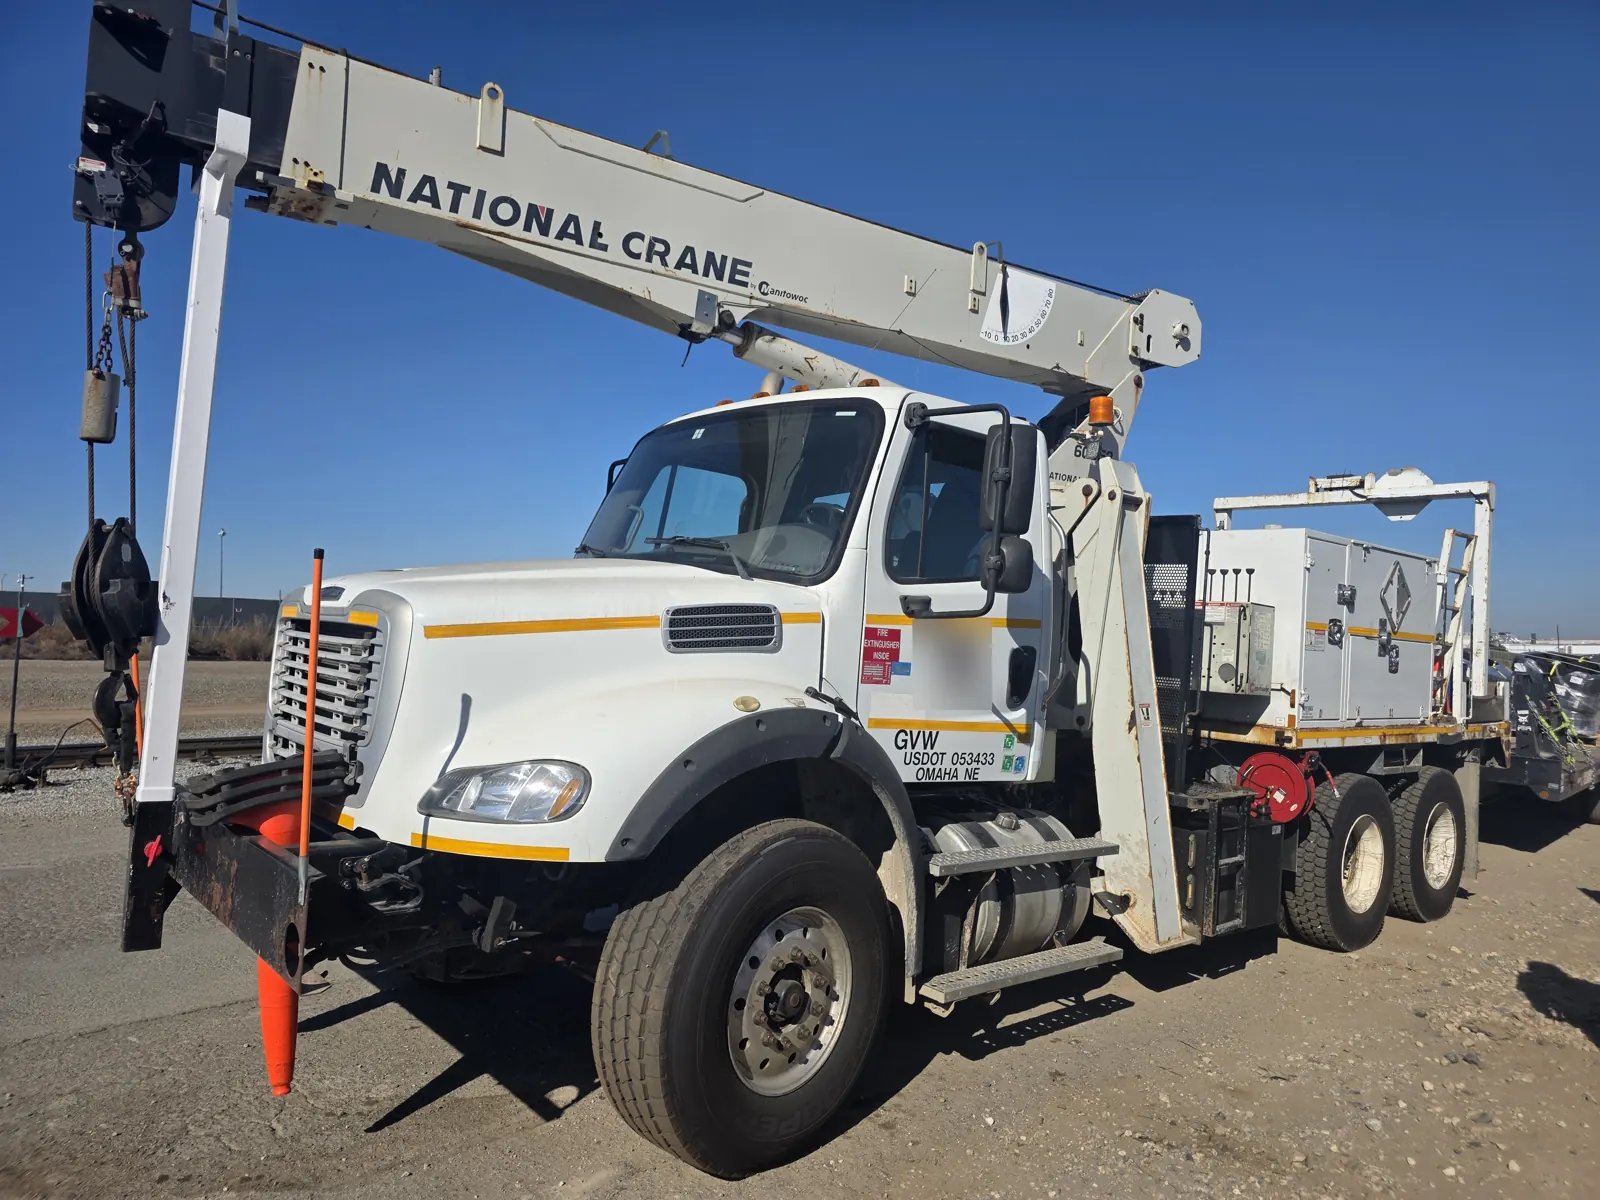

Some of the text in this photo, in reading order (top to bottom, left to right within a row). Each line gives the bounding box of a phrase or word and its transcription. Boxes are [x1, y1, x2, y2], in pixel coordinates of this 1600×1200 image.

[370, 161, 753, 288] NATIONAL CRANE
[758, 281, 809, 303] Manitowoc
[1047, 288, 1054, 299] 80
[1044, 299, 1052, 309] 70
[1040, 309, 1048, 319] 60
[1034, 318, 1042, 328] 50
[1028, 325, 1036, 334] 40
[1011, 334, 1019, 343] 20
[1020, 331, 1028, 340] 30
[877, 628, 889, 637] FIRE
[863, 639, 900, 649] EXTINGUISHER
[872, 651, 890, 660] INSIDE
[894, 728, 940, 751] GVW
[903, 751, 947, 766] USDOT
[951, 752, 995, 766] 053433
[915, 767, 981, 781] OMAHA NE
